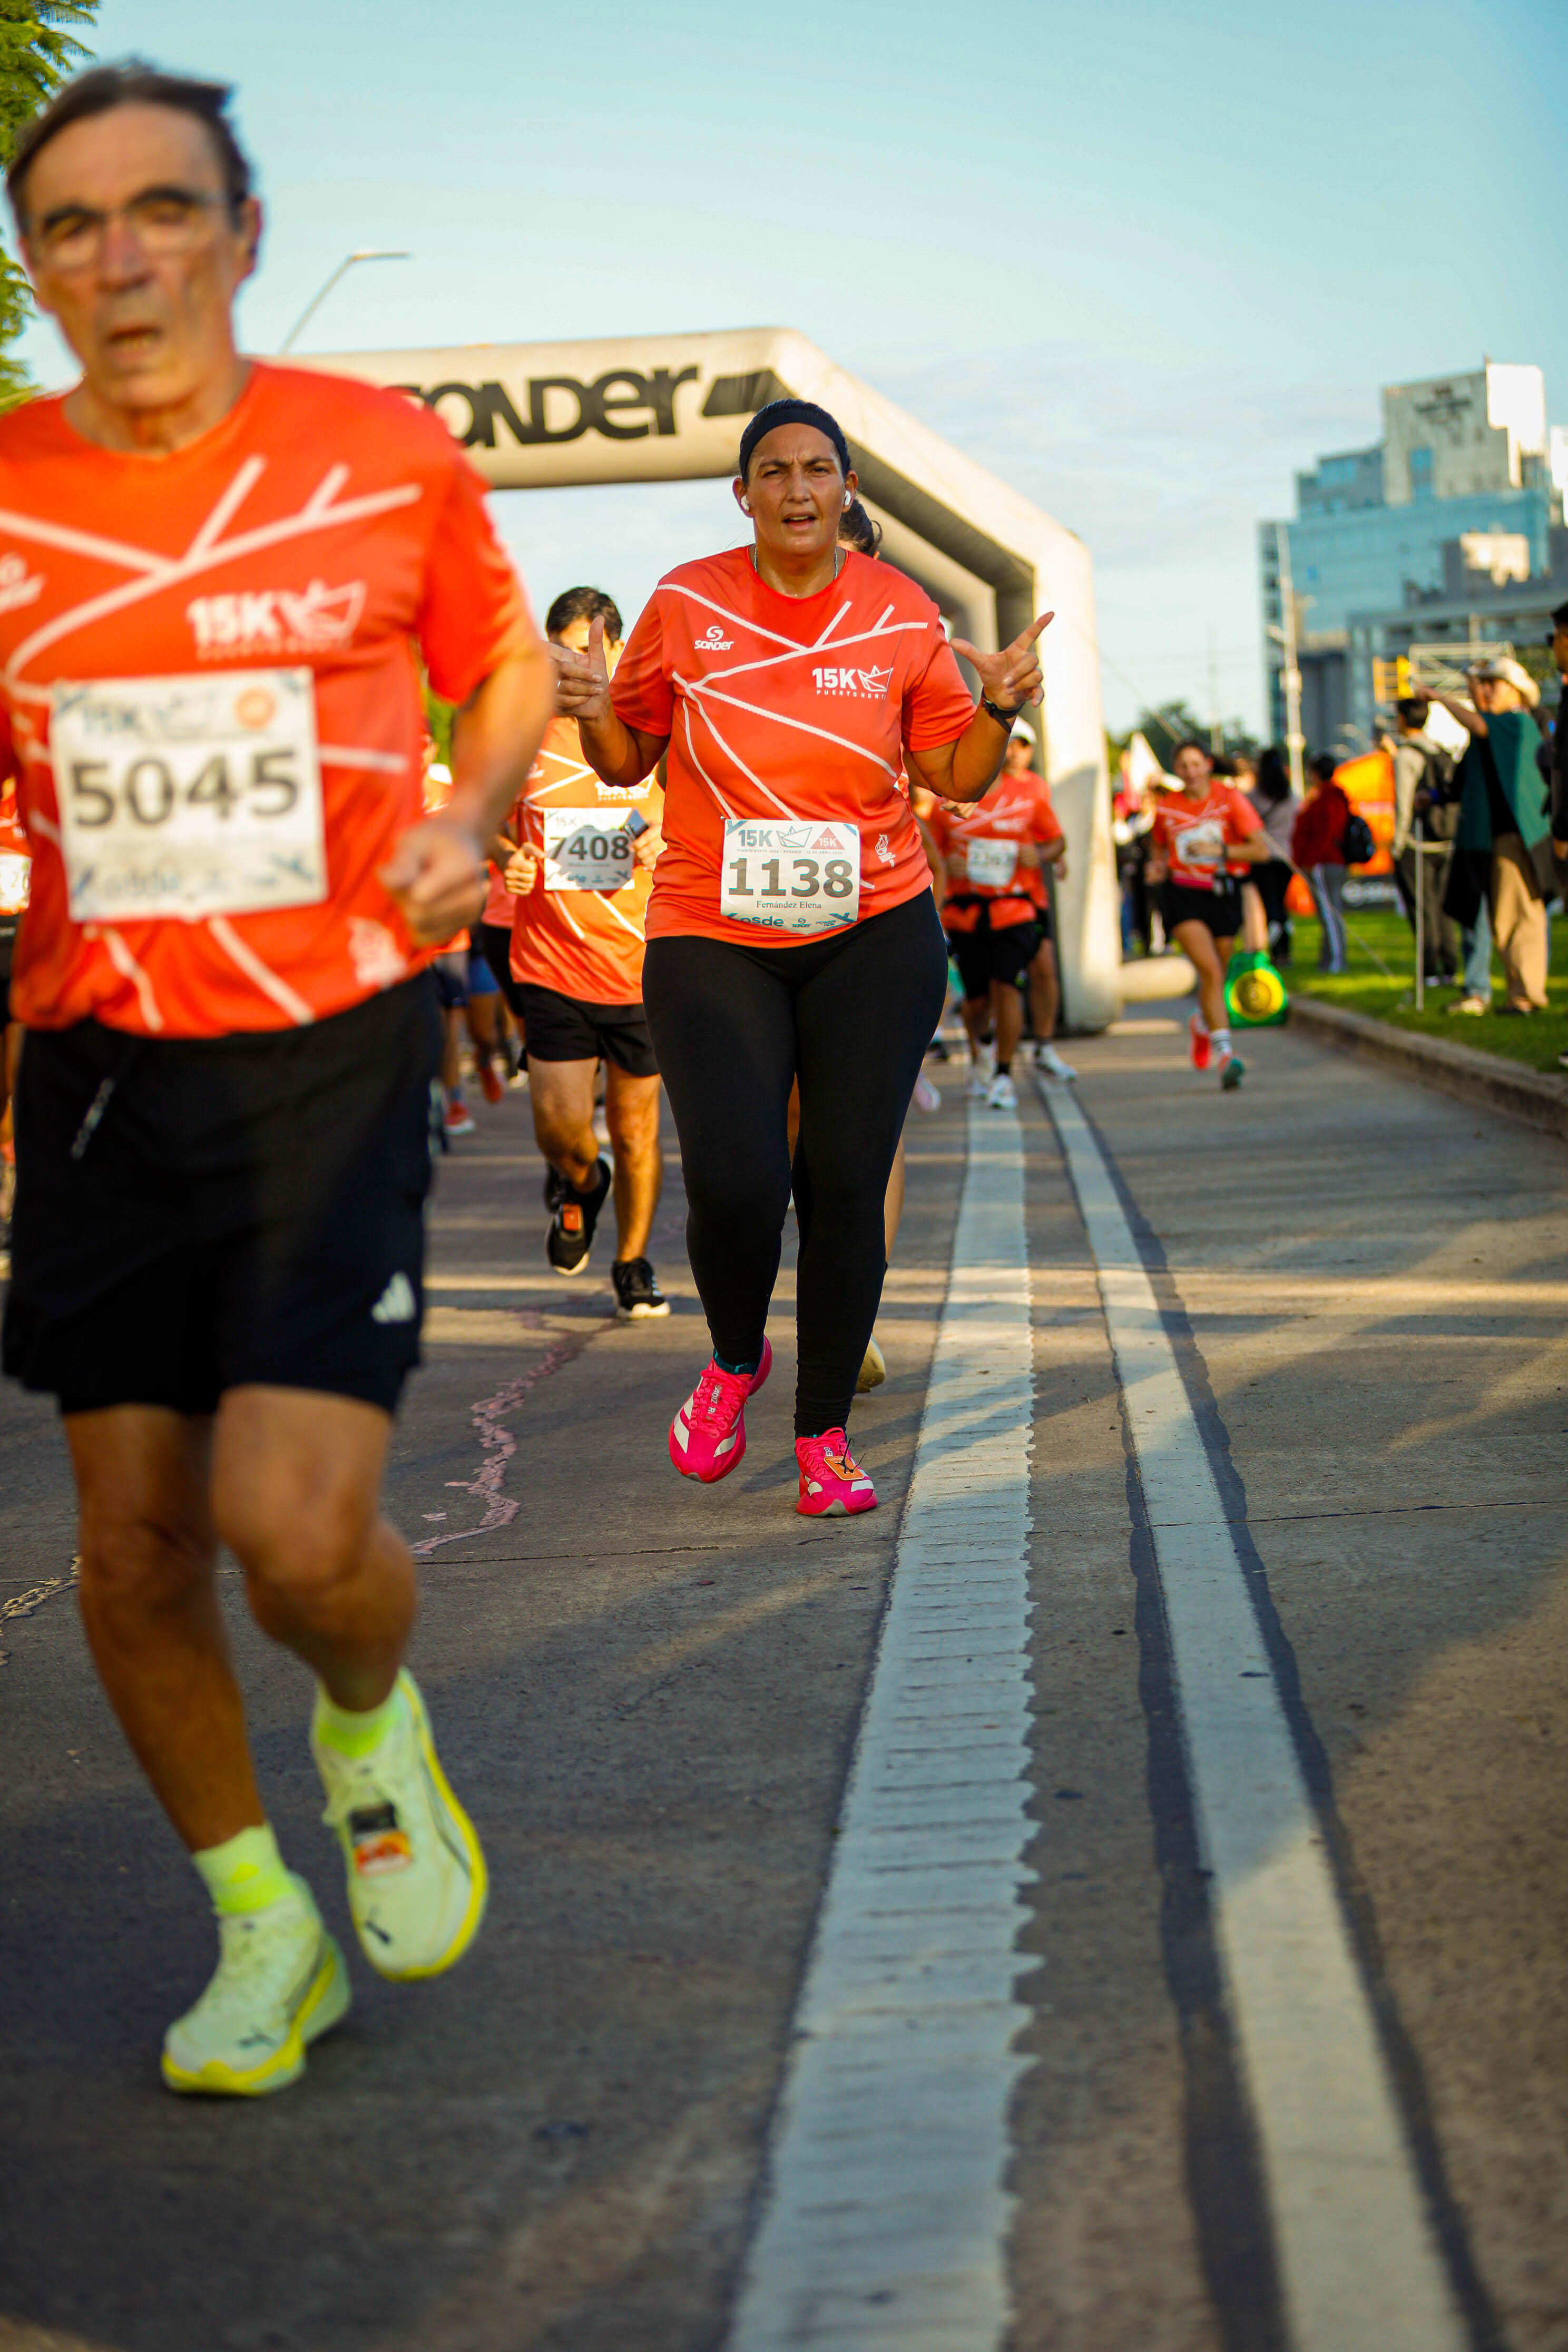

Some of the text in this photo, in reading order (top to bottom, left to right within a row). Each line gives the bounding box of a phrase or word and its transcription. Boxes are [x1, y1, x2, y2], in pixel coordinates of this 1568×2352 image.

[387, 366, 698, 447] ONDer
[187, 591, 280, 646] 15K
[812, 668, 857, 689] 15K
[71, 749, 300, 830] 5045
[550, 835, 629, 860] 7408
[739, 829, 772, 847] 15K
[819, 838, 837, 847] 15K
[729, 858, 853, 898] 1138
[740, 915, 784, 926] osde
